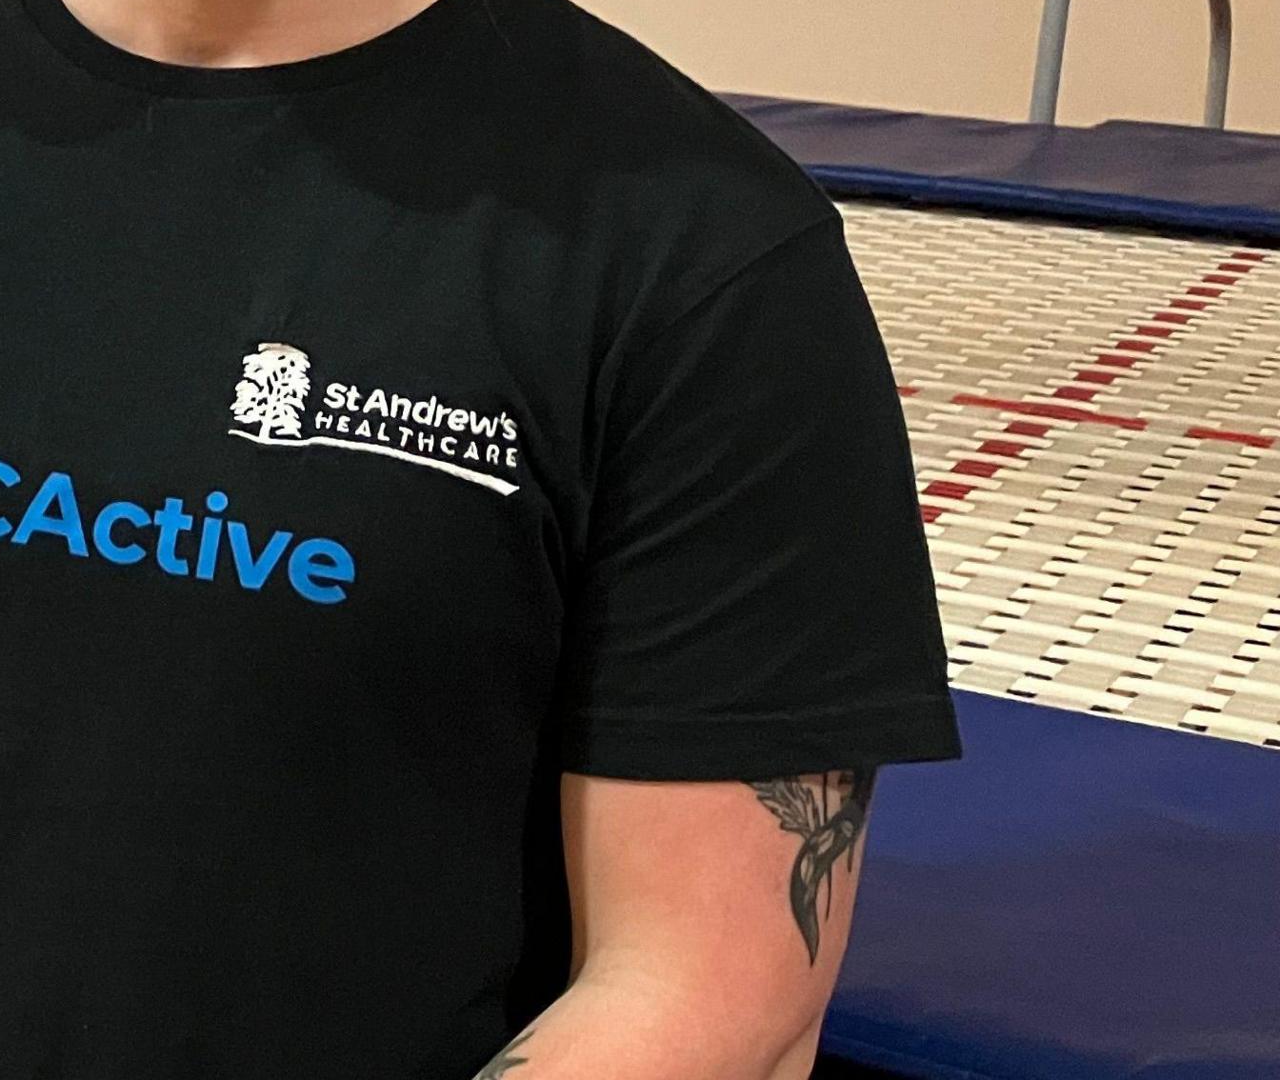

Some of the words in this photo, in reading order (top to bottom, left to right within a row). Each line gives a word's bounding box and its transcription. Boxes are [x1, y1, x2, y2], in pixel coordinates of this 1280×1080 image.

[314, 410, 519, 468] HEALTHCARE
[323, 382, 361, 412] St
[362, 388, 518, 441] Andrew's
